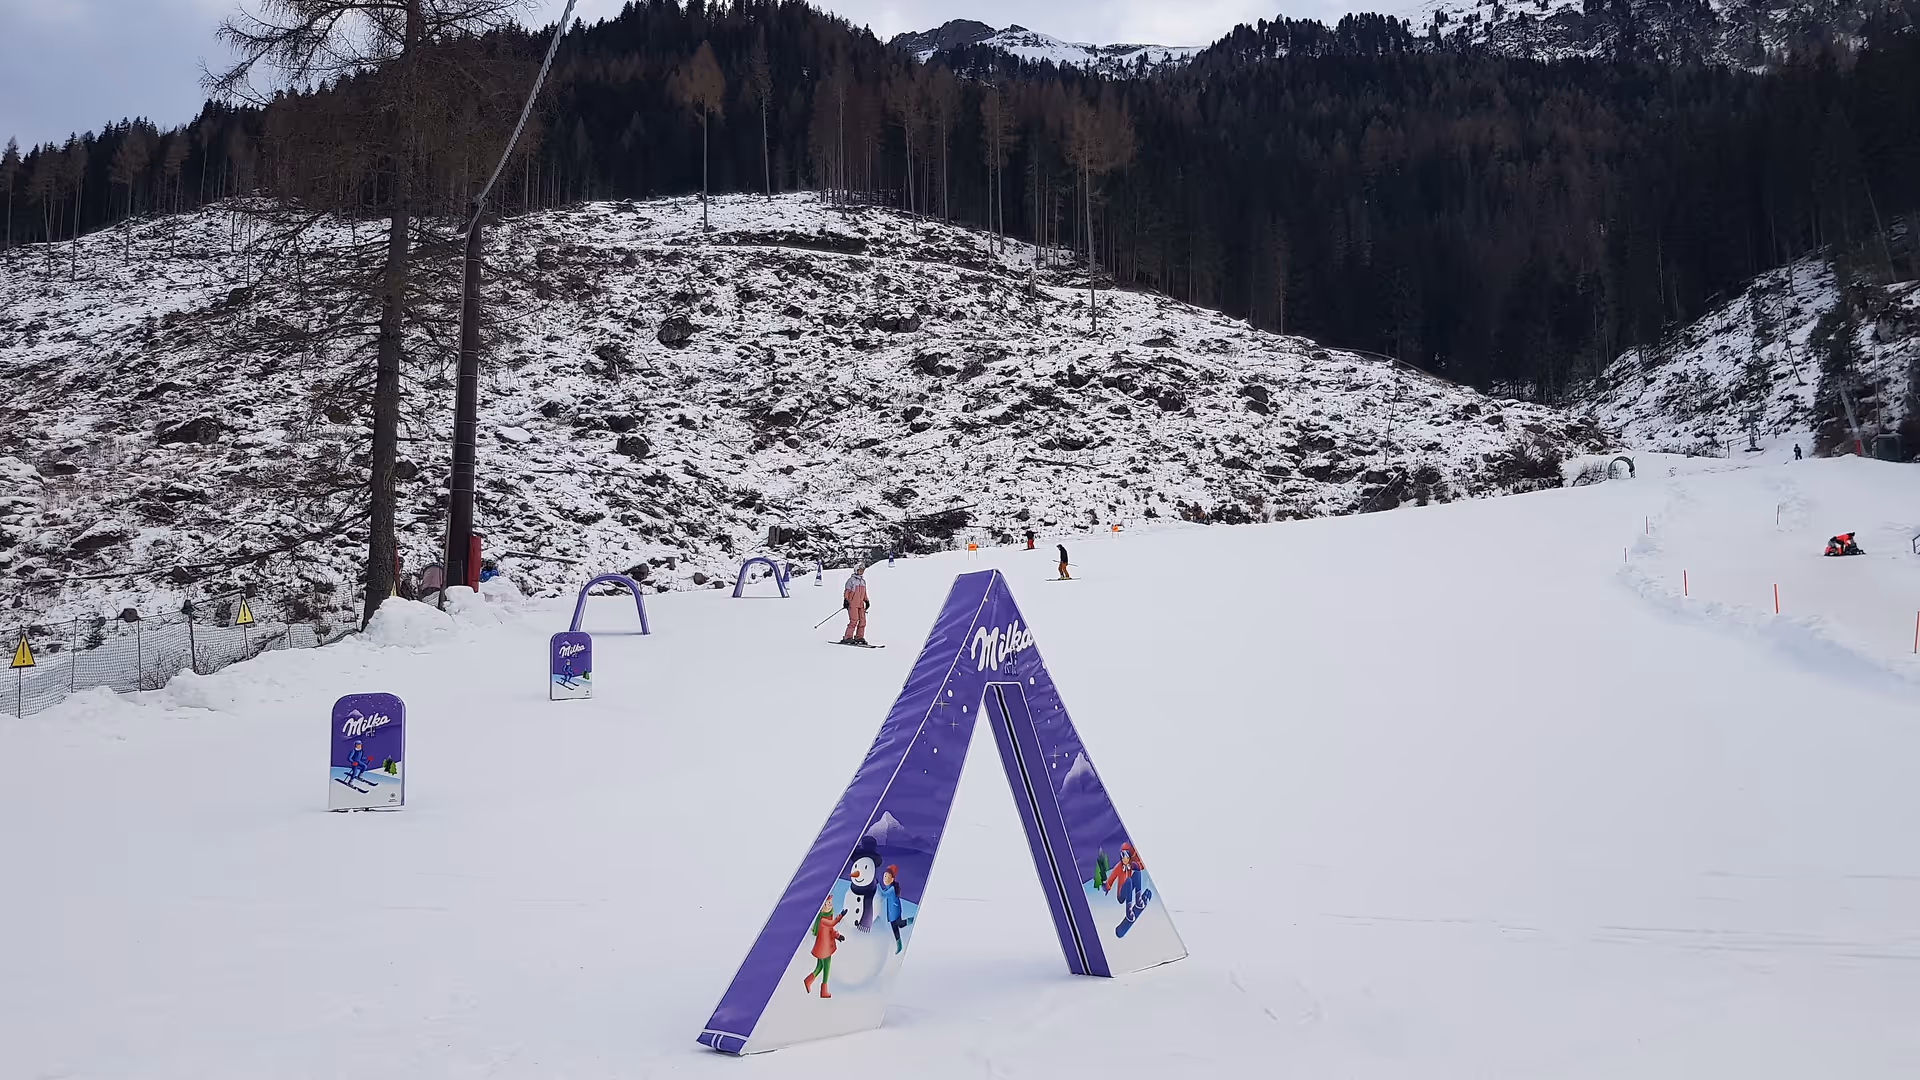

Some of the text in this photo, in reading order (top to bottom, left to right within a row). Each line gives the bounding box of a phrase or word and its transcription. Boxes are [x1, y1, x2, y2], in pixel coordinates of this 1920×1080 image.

[558, 643, 586, 657] Milka
[970, 619, 1035, 671] Milka
[342, 713, 391, 737] Milka
